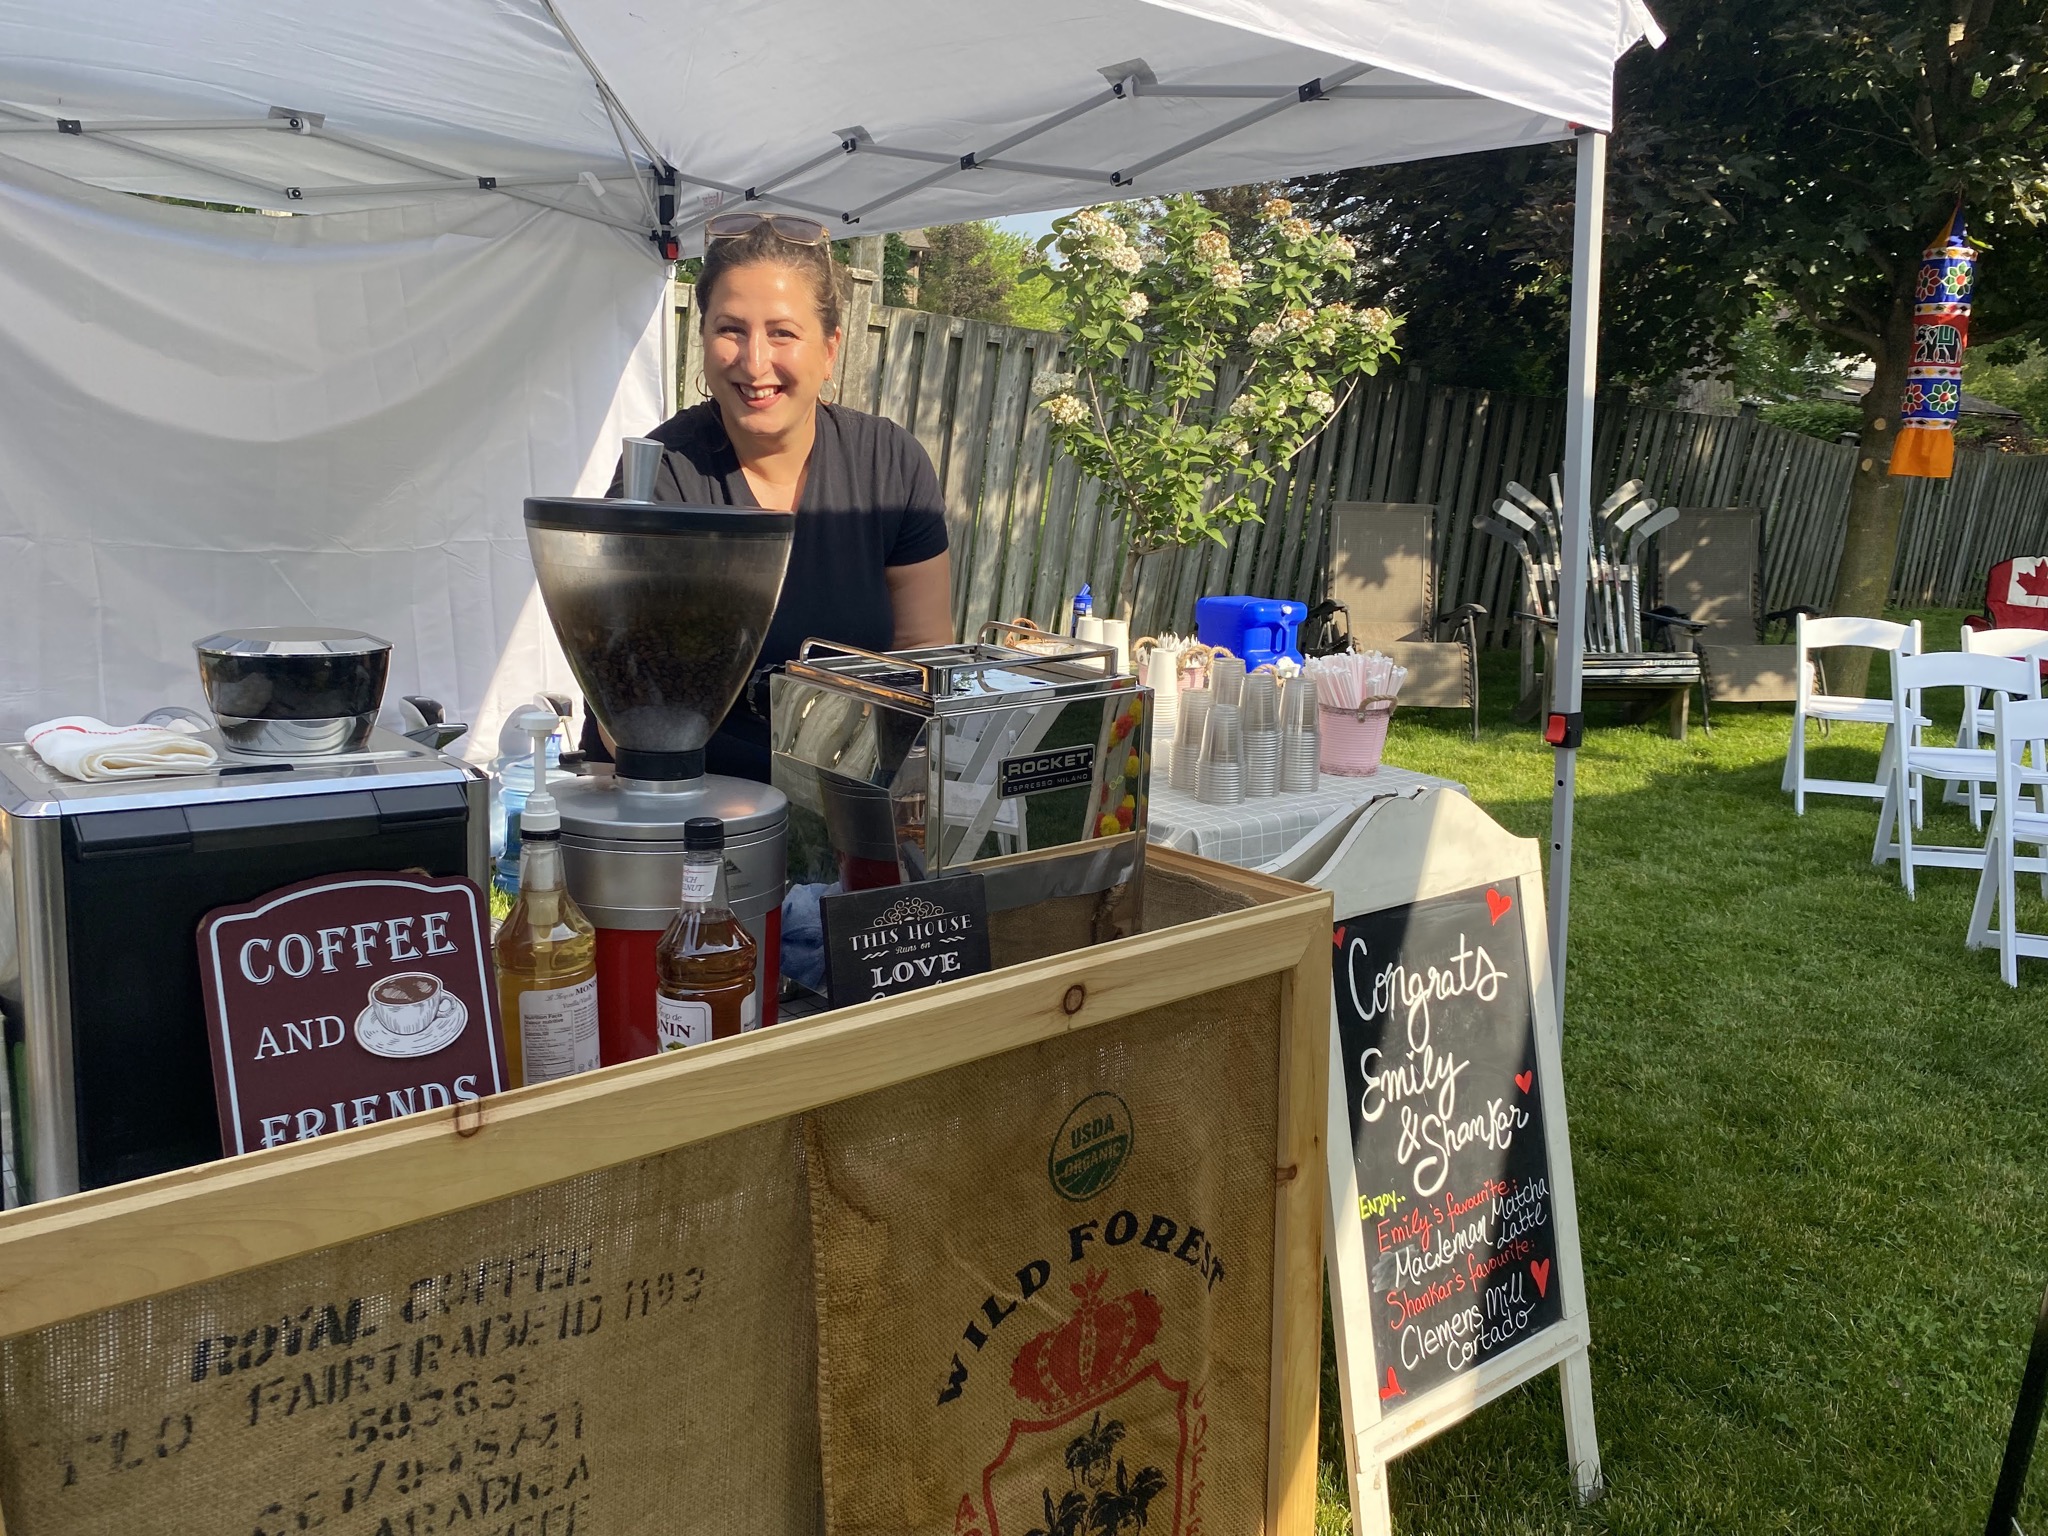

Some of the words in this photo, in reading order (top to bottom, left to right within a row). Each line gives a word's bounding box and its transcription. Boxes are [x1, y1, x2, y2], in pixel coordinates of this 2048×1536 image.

[1007, 752, 1088, 776] ROCKET
[1007, 779, 1053, 793] ESPRESSO
[1057, 773, 1088, 783] MILANO
[239, 911, 458, 985] COFFEE
[849, 927, 899, 951] THIS
[907, 914, 972, 940] HOUSE
[895, 944, 917, 955] Runs
[920, 941, 931, 950] on
[870, 951, 961, 989] LOVE
[1348, 933, 1508, 1053] Congrats
[254, 1015, 346, 1060] AND
[1360, 1044, 1470, 1122] Emily
[260, 1075, 482, 1149] FRIENDS
[1071, 1113, 1115, 1150] USDA
[1063, 1141, 1122, 1178] ORGANIC
[1490, 1176, 1550, 1226] Matcha
[1497, 1202, 1548, 1250] Latte
[1377, 1203, 1445, 1254] Emily's
[936, 1258, 1051, 1407] WILD
[1067, 1209, 1226, 1295] FOREST
[1401, 1304, 1484, 1372] Clemens
[1485, 1271, 1527, 1321] Mill
[248, 1304, 548, 1427] FAIRTRADE
[556, 1294, 603, 1341] ID
[1446, 1302, 1536, 1372] Cortado
